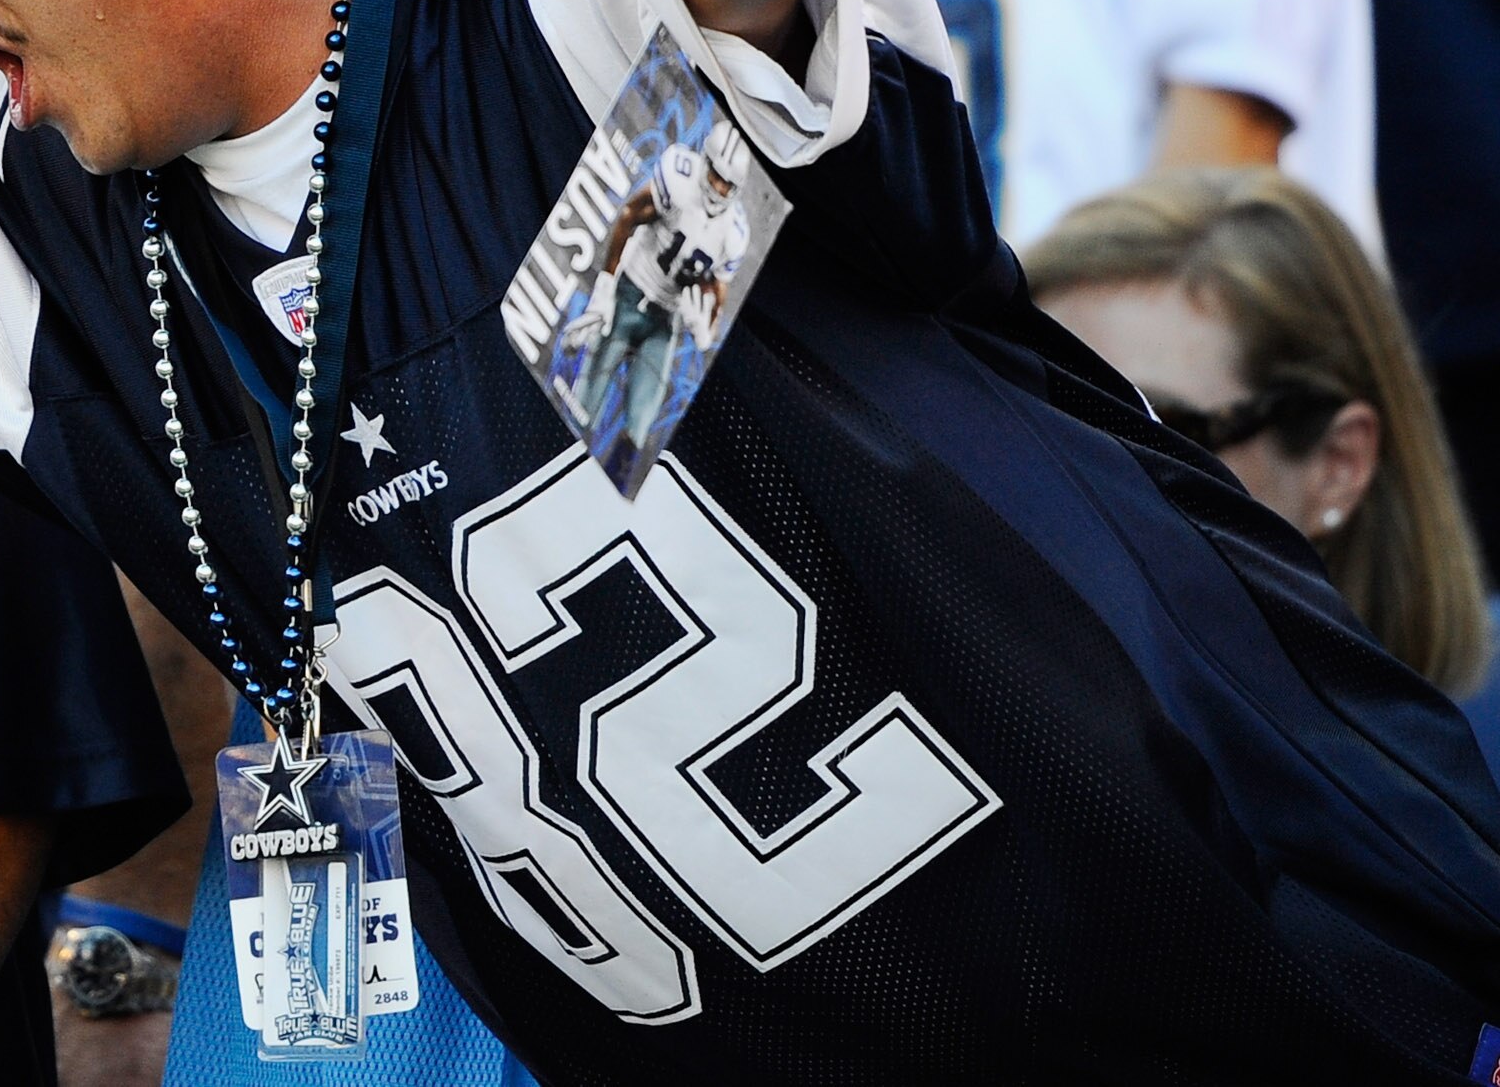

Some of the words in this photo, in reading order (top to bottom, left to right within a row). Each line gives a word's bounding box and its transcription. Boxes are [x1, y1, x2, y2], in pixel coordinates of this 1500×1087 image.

[501, 126, 634, 364] AUSTIN
[312, 450, 1004, 1027] 82
[230, 822, 339, 861] COWBOYS
[289, 884, 312, 943] BLUE
[289, 960, 309, 1014] TRUE
[375, 990, 409, 1005] 2848
[276, 1016, 310, 1036] TRUE
[321, 1016, 358, 1038] BLUE
